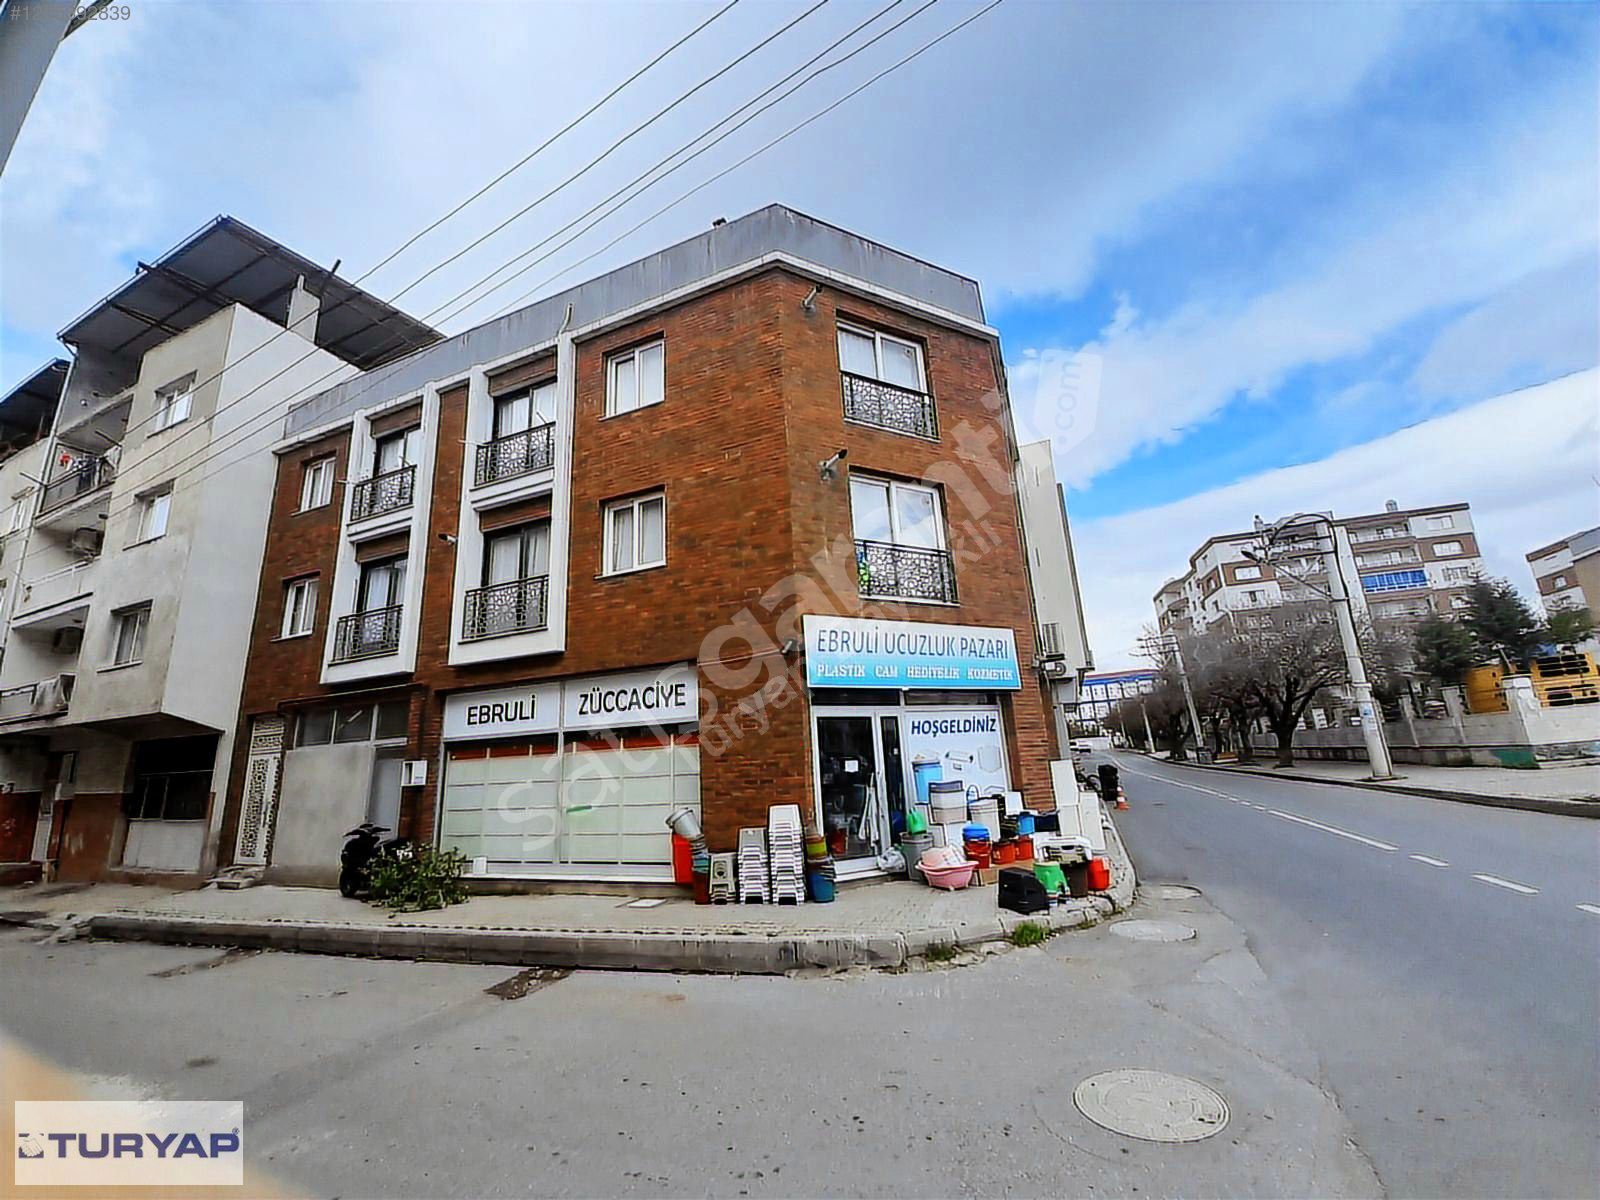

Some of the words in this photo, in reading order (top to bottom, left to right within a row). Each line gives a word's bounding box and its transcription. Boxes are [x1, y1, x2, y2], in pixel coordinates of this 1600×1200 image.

[817, 626, 879, 654] EBRULİ
[884, 631, 956, 656] UCUZLUK
[961, 637, 1009, 659] PAZARI
[467, 694, 536, 725] EBRULİ
[578, 680, 686, 715] ZÜCCACİYE
[911, 715, 997, 737] HOŞGELDİNİZ
